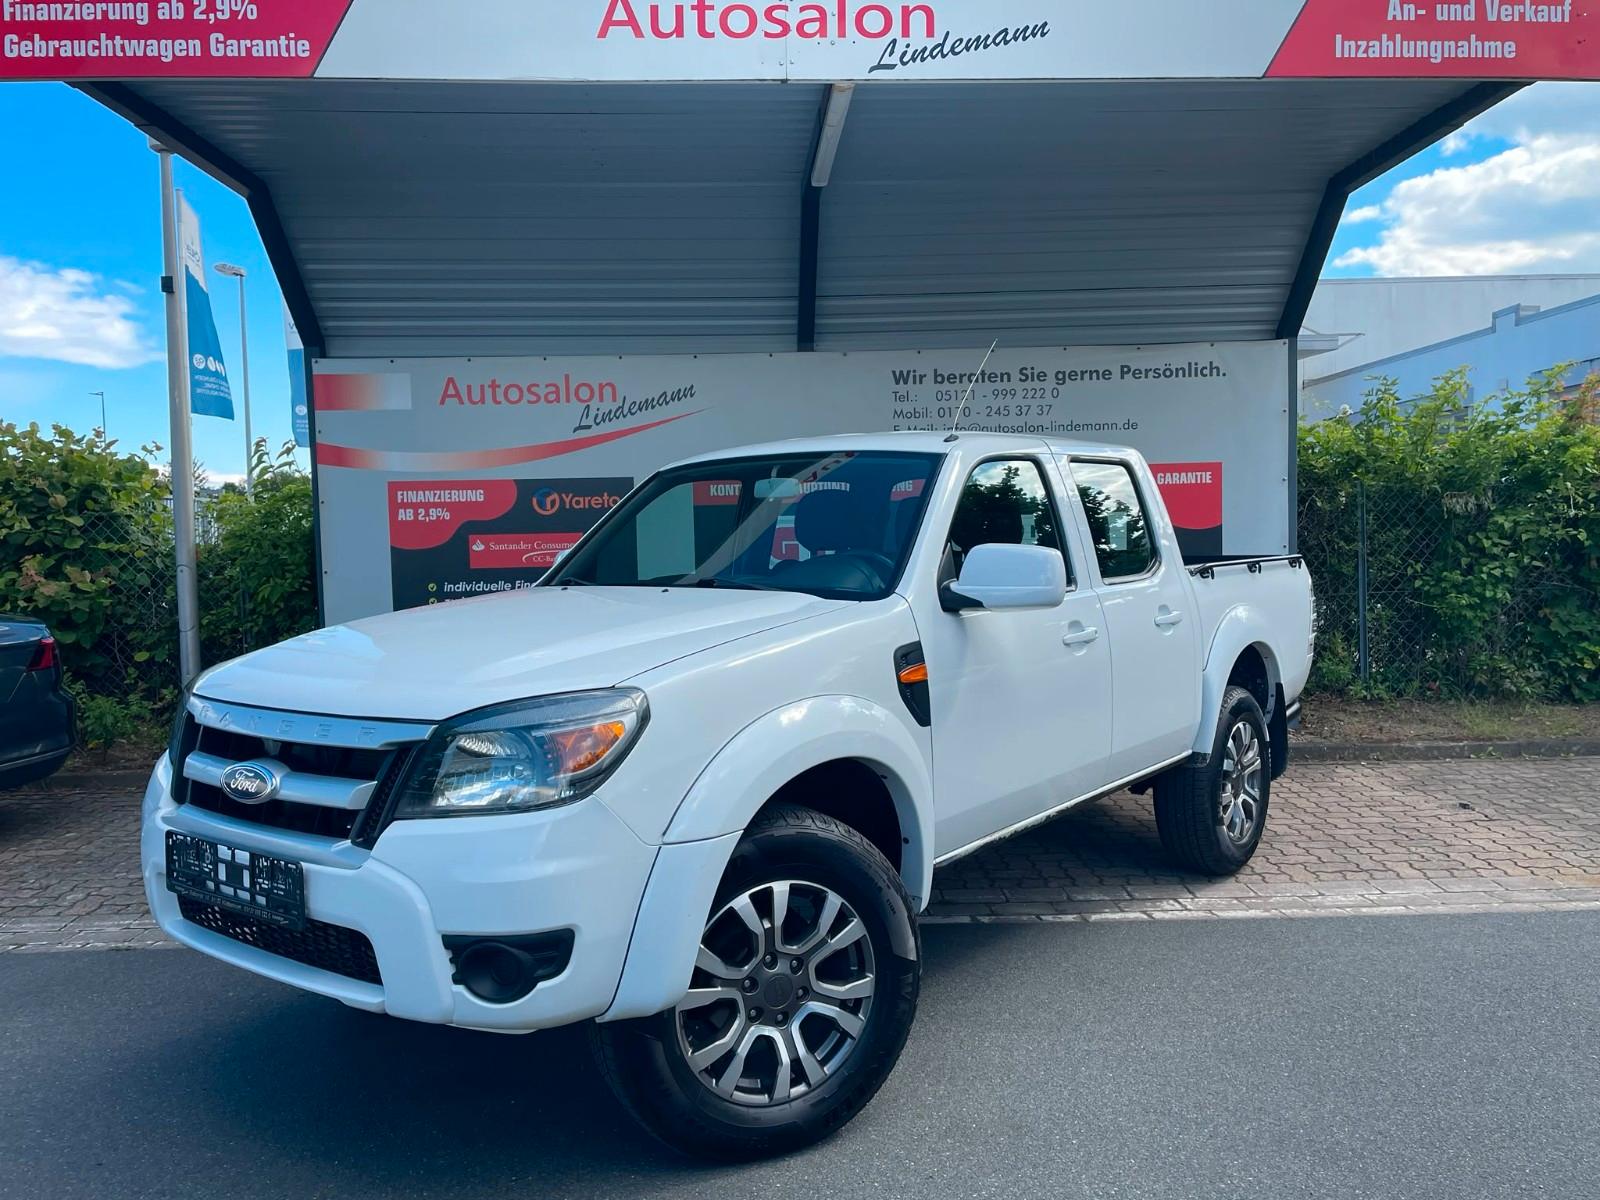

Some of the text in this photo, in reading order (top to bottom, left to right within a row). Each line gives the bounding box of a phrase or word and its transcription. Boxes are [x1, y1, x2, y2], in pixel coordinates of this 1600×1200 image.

[3, 0, 258, 25] Finanzierung ab 2,9%
[596, 0, 936, 40] Autosalon
[1386, 0, 1572, 23] An- und Verkauf
[3, 31, 311, 63] Gebrauchtwagen Garantie
[867, 19, 1052, 74] Lindemann
[1335, 33, 1517, 64] Inzahlungnahme
[891, 361, 1228, 386] Wir beraten Sie gerne Persönlich.
[439, 373, 619, 406] Autosalon
[892, 391, 918, 403] Tel.:
[992, 388, 1017, 401] 999
[1021, 387, 1046, 400] 222
[1051, 387, 1060, 399] 0
[572, 383, 697, 434] Lindemann
[892, 407, 933, 420] Mobil:
[985, 405, 1011, 418] 245
[1015, 404, 1032, 417] 37
[1036, 404, 1053, 417] 37
[1156, 471, 1213, 485] GARANTIE
[396, 488, 485, 503] FINANZIERUNG
[398, 507, 451, 523] AB 2,9%
[488, 540, 533, 551] Santander
[443, 580, 512, 592] individuelle
[230, 769, 260, 793] Ford
